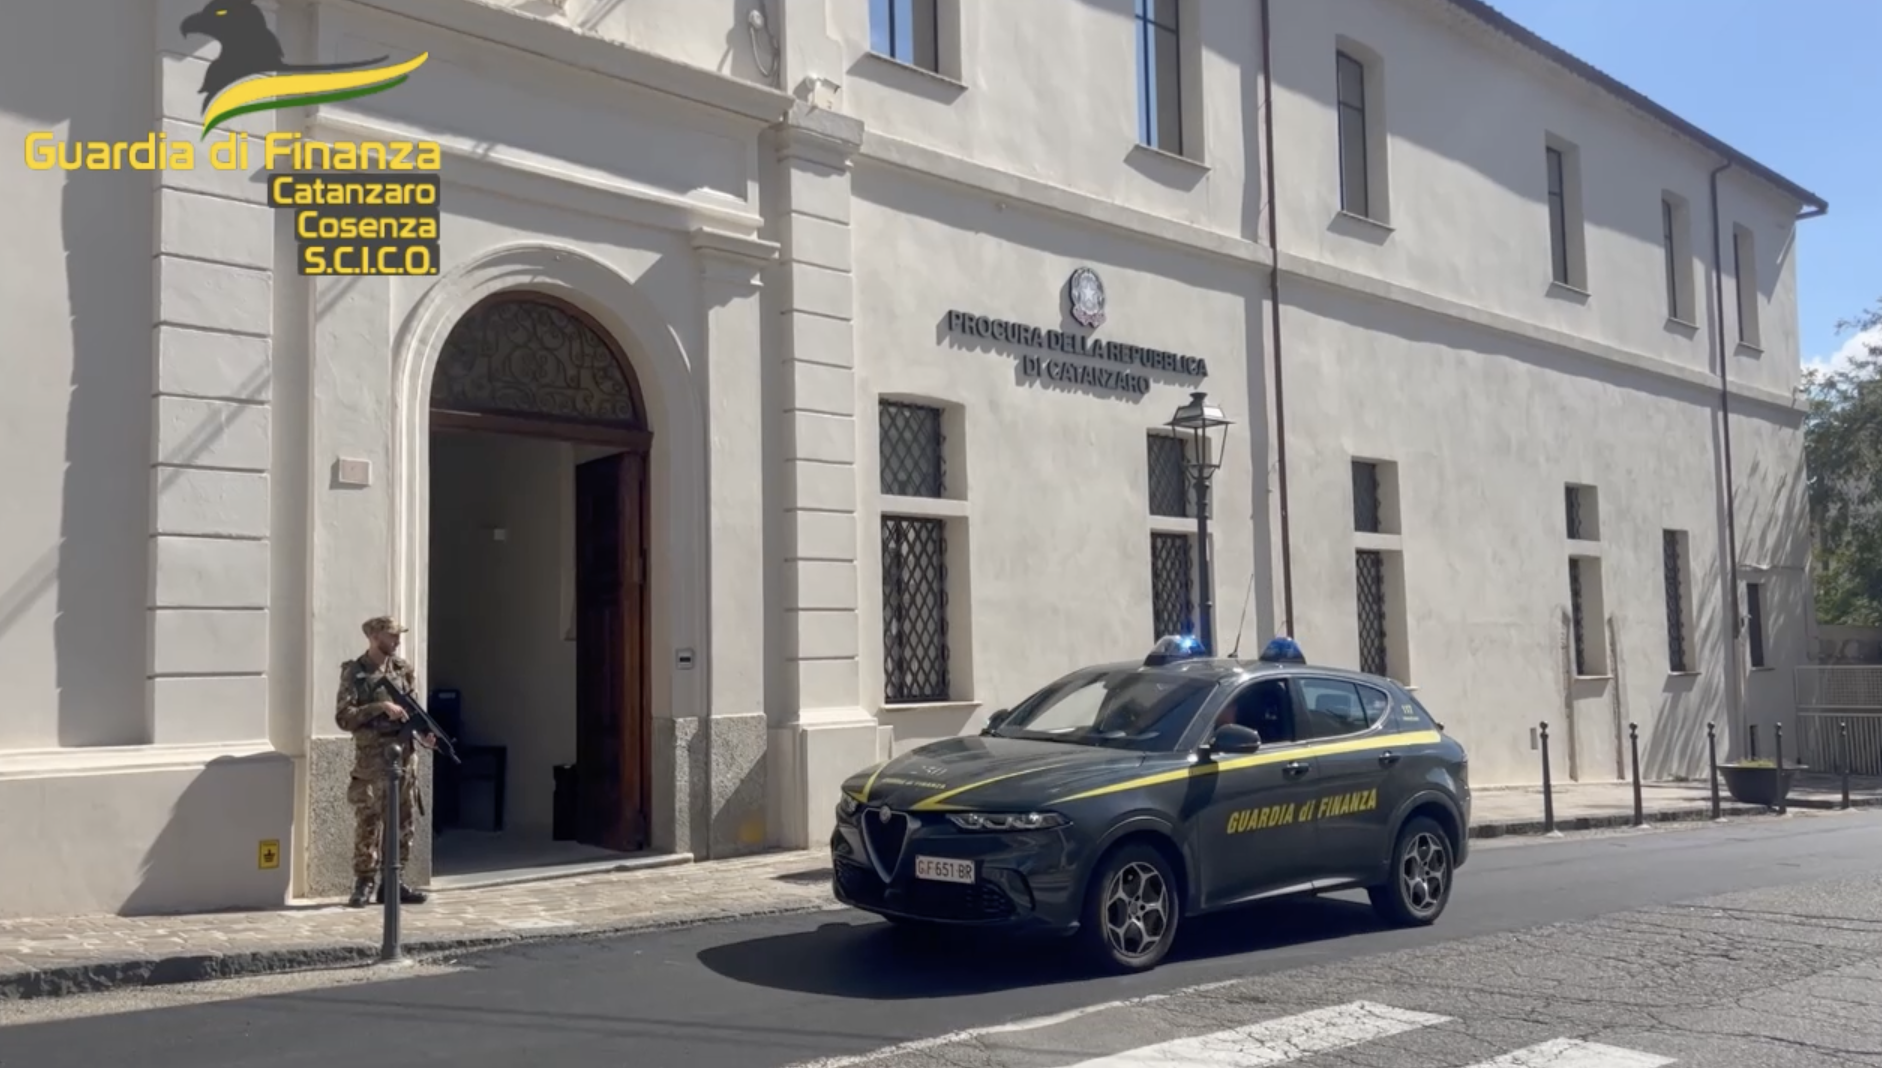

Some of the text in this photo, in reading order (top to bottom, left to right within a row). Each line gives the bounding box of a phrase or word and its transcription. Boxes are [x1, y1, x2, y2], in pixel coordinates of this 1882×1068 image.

[949, 310, 1042, 348] PROCURA
[1045, 329, 1104, 358] DELLA
[1107, 341, 1208, 377] REPUBBLICA
[1022, 355, 1150, 395] DI CATANZARO
[1226, 788, 1378, 834] GUARDIA di FINANZA
[935, 861, 953, 878] 651
[958, 863, 972, 880] BR
